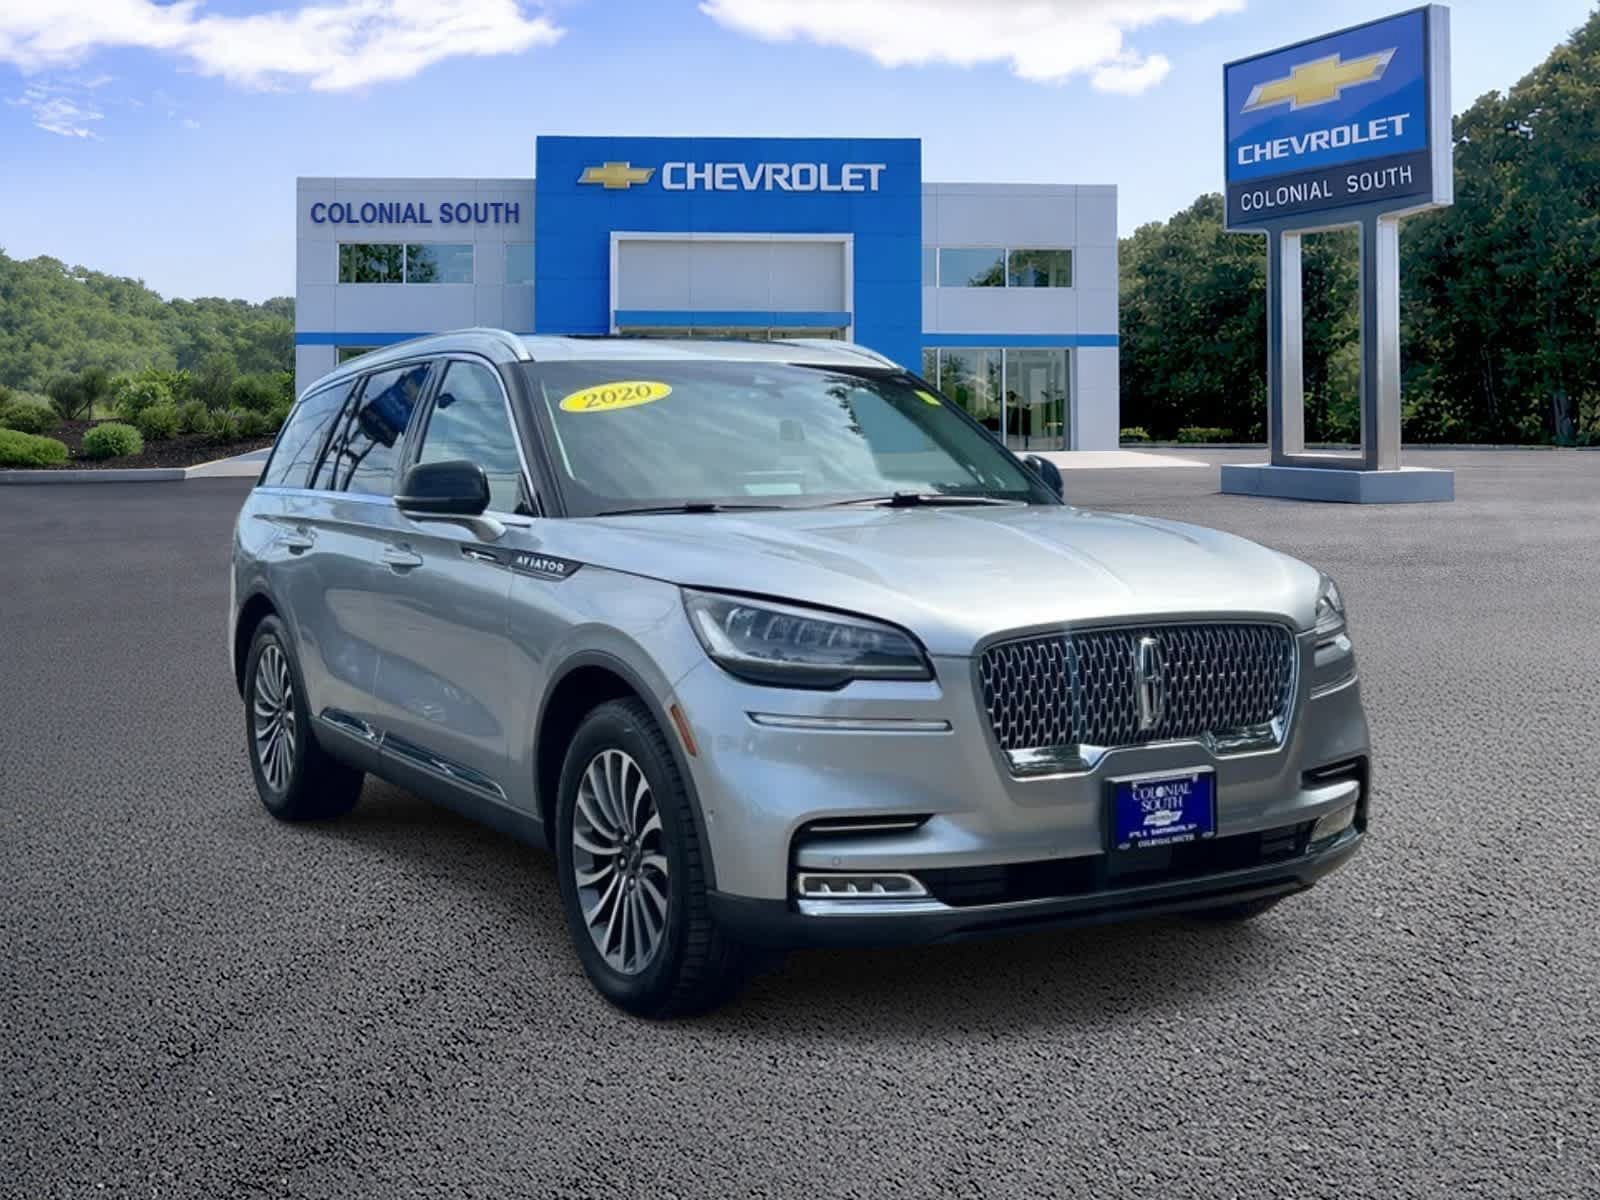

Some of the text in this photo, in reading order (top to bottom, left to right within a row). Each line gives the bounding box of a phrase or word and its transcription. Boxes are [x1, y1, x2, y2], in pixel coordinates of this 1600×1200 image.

[1237, 113, 1410, 165] CHEVROLET
[662, 162, 887, 192] CHEVROLET
[1240, 165, 1412, 211] COLONIAL SOUTH
[310, 202, 520, 224] COLONIAL SOUTH
[583, 384, 652, 408] 2020
[516, 555, 565, 573] AVIATOR
[1131, 782, 1192, 801] COLONIAL
[1141, 796, 1184, 813] SOUTH
